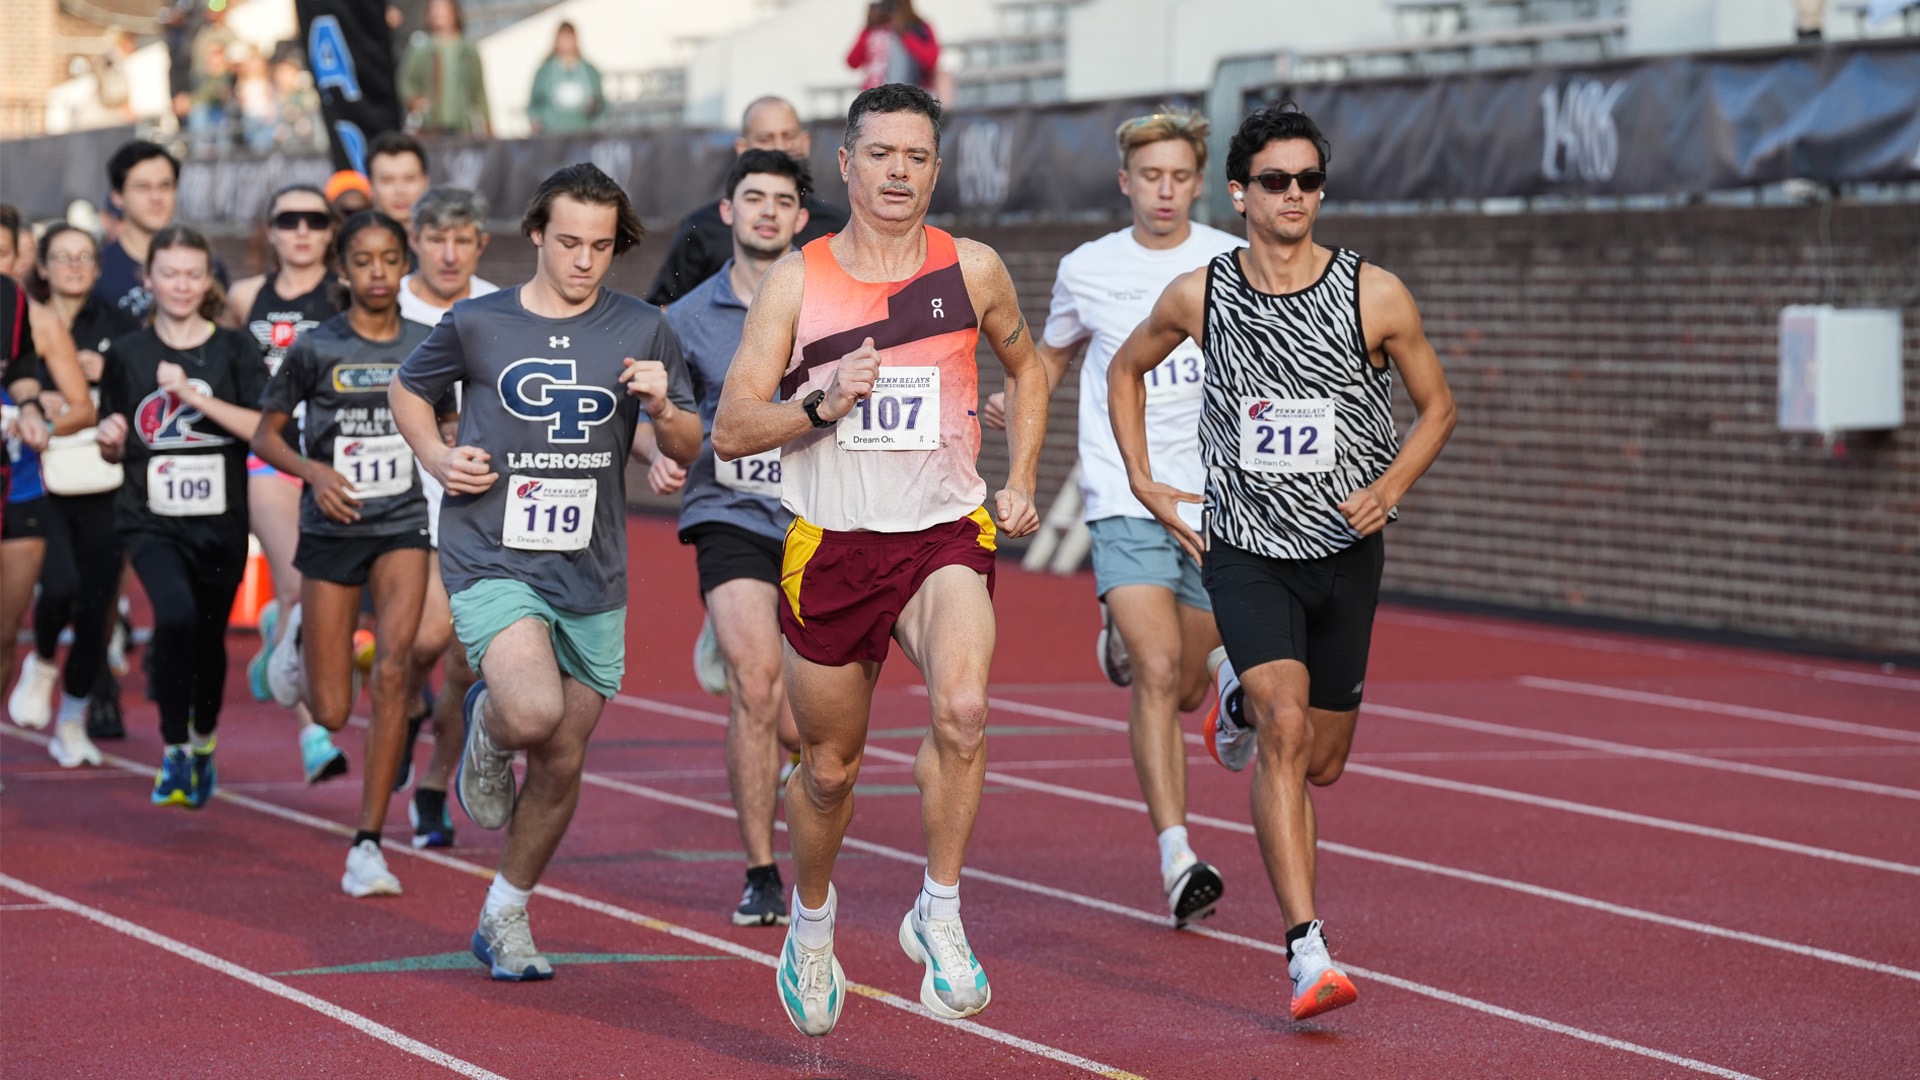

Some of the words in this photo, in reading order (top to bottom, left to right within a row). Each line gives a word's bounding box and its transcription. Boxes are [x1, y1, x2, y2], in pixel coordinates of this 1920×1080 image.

[1151, 357, 1201, 387] 113
[497, 357, 617, 443] GP
[856, 395, 923, 431] 107
[340, 421, 385, 435] WALK
[1256, 425, 1318, 455] 212
[350, 458, 397, 482] 111
[507, 452, 612, 469] LACROSSE
[731, 459, 782, 483] 128
[1254, 458, 1278, 467] Dream
[166, 479, 211, 500] 109
[524, 504, 580, 533] 119
[517, 536, 540, 544] Dream
